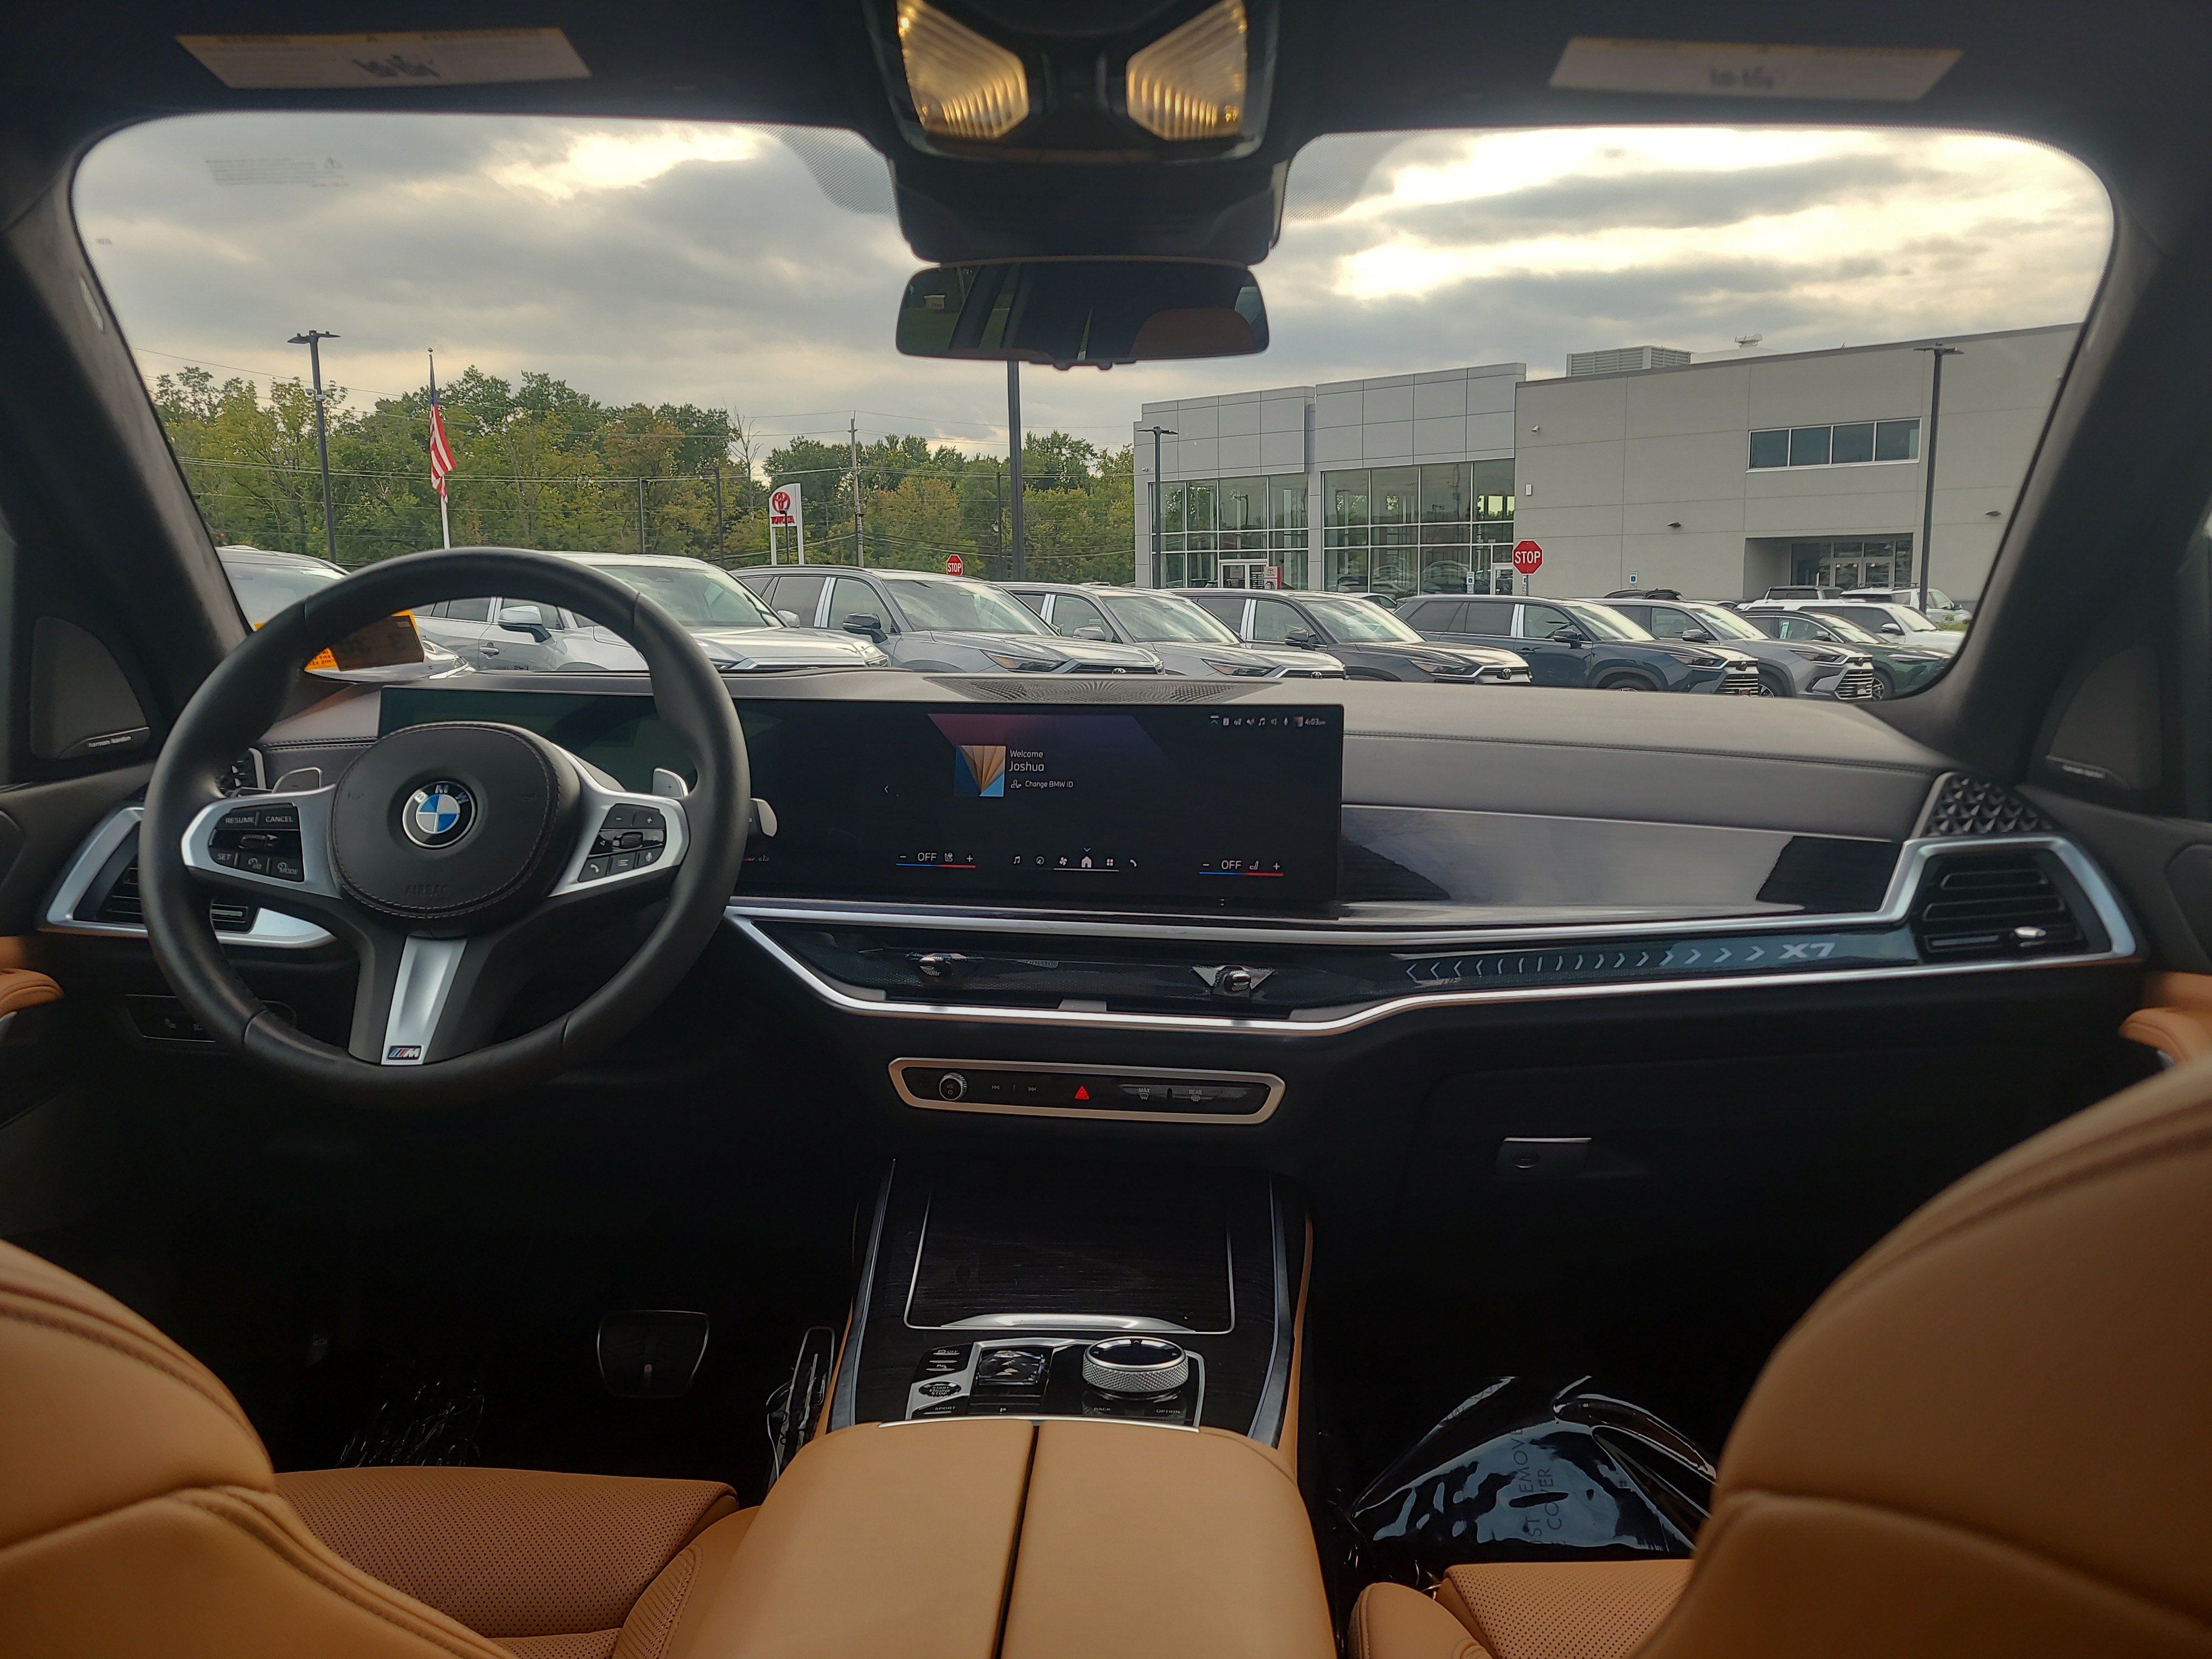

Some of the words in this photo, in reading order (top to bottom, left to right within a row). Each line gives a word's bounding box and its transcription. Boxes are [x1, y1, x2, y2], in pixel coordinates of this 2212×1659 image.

[1515, 551, 1541, 564] STOP
[947, 562, 962, 573] STOP
[1010, 749, 1043, 758] Welcome
[1008, 760, 1045, 772] Joshua
[1025, 780, 1048, 788] Change
[414, 784, 470, 805] BMW
[917, 852, 937, 862] OFF
[1221, 860, 1242, 870] OFF
[1778, 943, 1836, 960] X7
